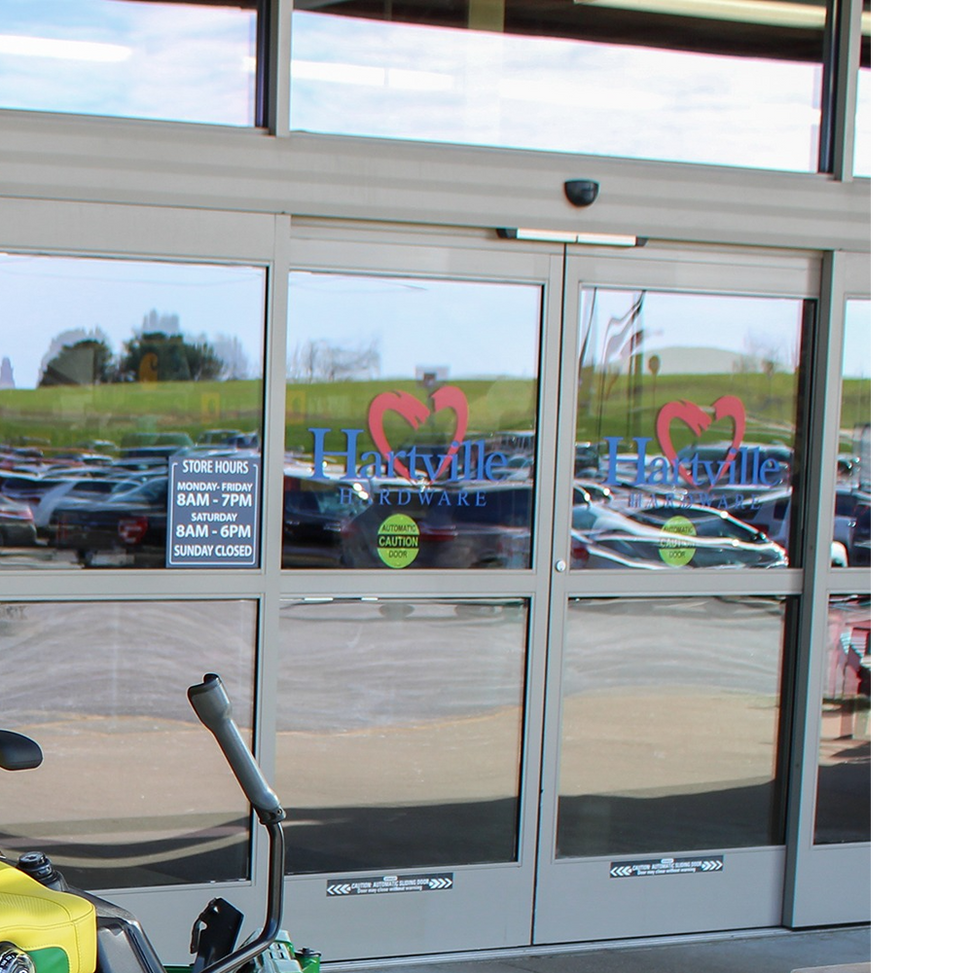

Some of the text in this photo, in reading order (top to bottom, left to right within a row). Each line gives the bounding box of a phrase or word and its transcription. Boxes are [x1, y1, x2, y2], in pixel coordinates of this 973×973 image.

[308, 428, 508, 483] Hartville
[182, 460, 249, 474] STORE HOURS
[602, 437, 781, 487] Hartville
[222, 483, 253, 492] FRIDAY
[177, 493, 209, 507] 8AM
[222, 494, 252, 507] 7PM
[191, 512, 238, 522] SATURDAY
[176, 524, 208, 538] 8AM
[220, 525, 251, 538] 6PM
[382, 524, 416, 533] AUTOMATIC
[663, 525, 693, 534] AUTOMATIC
[379, 536, 418, 547] CAUTION
[174, 544, 252, 557] SUNDAY CLOSED
[388, 550, 407, 558] DOOR
[669, 551, 685, 559] DOOR
